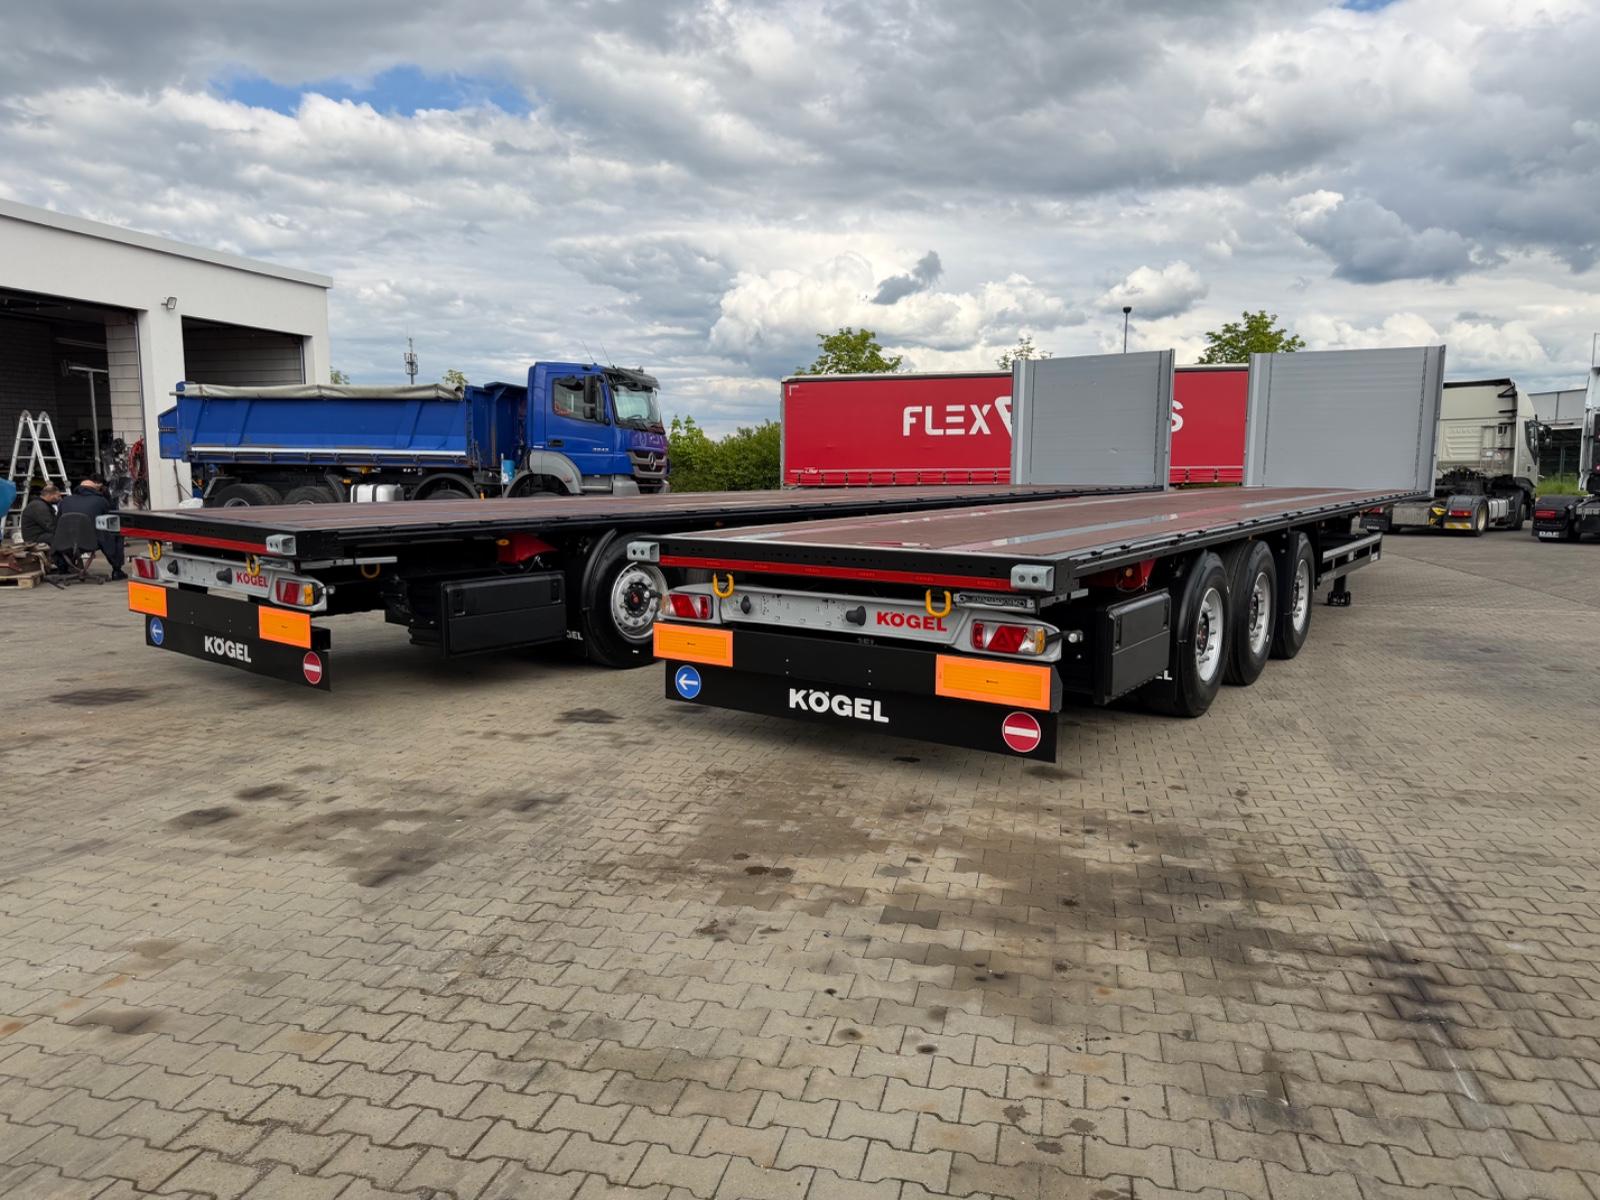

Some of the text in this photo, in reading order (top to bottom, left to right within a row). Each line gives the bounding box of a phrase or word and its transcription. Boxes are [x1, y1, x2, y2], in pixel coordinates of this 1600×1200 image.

[902, 404, 992, 437] FLEX
[876, 610, 948, 632] KÖGEL
[204, 634, 252, 663] KÖGEL
[788, 687, 890, 724] KÖGEL
